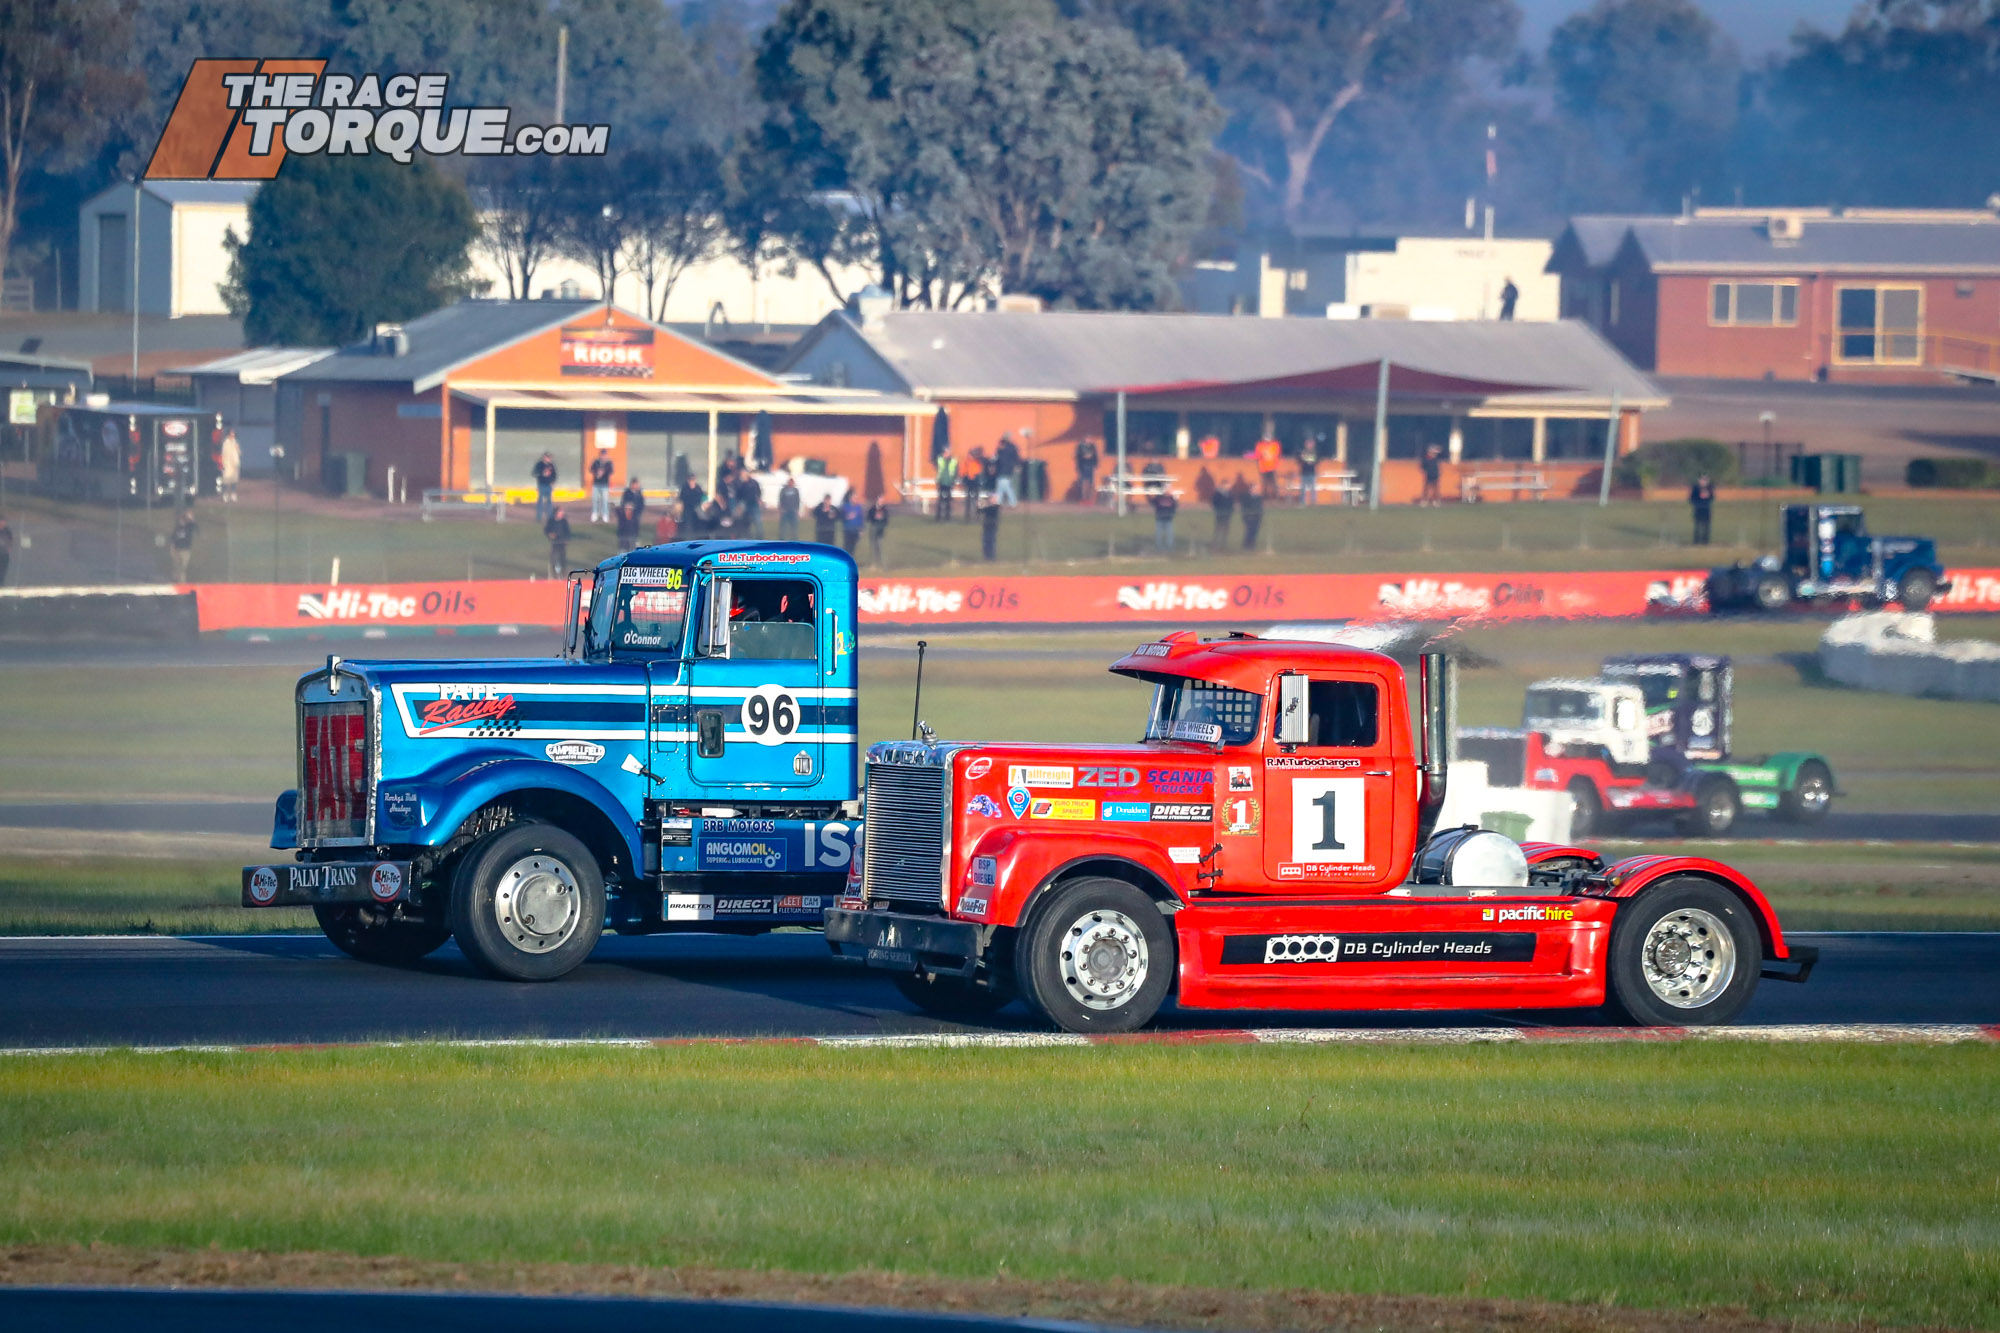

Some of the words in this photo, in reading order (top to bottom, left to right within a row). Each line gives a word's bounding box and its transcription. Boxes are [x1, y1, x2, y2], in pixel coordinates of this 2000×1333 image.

[574, 342, 642, 363] KIOSK
[623, 568, 638, 578] BIG
[639, 568, 669, 578] WHEELS
[666, 568, 683, 590] 96
[880, 585, 963, 613] Hi-Tec
[967, 585, 1019, 609] Oils
[1144, 583, 1229, 610] Hi-Tec
[1233, 584, 1285, 607] Oils
[323, 591, 416, 619] Hi-Tec
[422, 591, 477, 615] Oils
[624, 630, 661, 645] O'Connor
[420, 694, 516, 728] Racing
[748, 694, 795, 735] 96
[1187, 722, 1215, 735] WHEELS
[1028, 768, 1071, 781] allfreight
[1077, 767, 1140, 787] ZED
[1147, 770, 1214, 783] SCANIA
[1153, 784, 1203, 795] TRUCKS
[1152, 805, 1212, 816] DIRECT
[1232, 800, 1247, 824] 1
[703, 820, 724, 832] BRB
[727, 820, 775, 833] MOTORS
[1312, 790, 1345, 850] 1
[706, 842, 769, 856] ANGLOMOIL
[804, 822, 864, 867] IS
[978, 859, 991, 870] BSP
[1306, 864, 1318, 872] DB
[1319, 864, 1351, 873] Cylinder
[1352, 864, 1376, 872] Heads
[260, 873, 277, 888] Hi-Tec
[289, 866, 319, 891] PALM
[321, 865, 357, 889] TRANS
[382, 870, 401, 884] Hi-Tec
[973, 873, 995, 885] DIESEL
[717, 899, 771, 909] DIRECT
[779, 896, 801, 906] FLEET
[803, 897, 819, 906] CAM
[1344, 943, 1367, 954] DB
[1372, 941, 1440, 958] Cylinder
[1443, 941, 1493, 955] Heads
